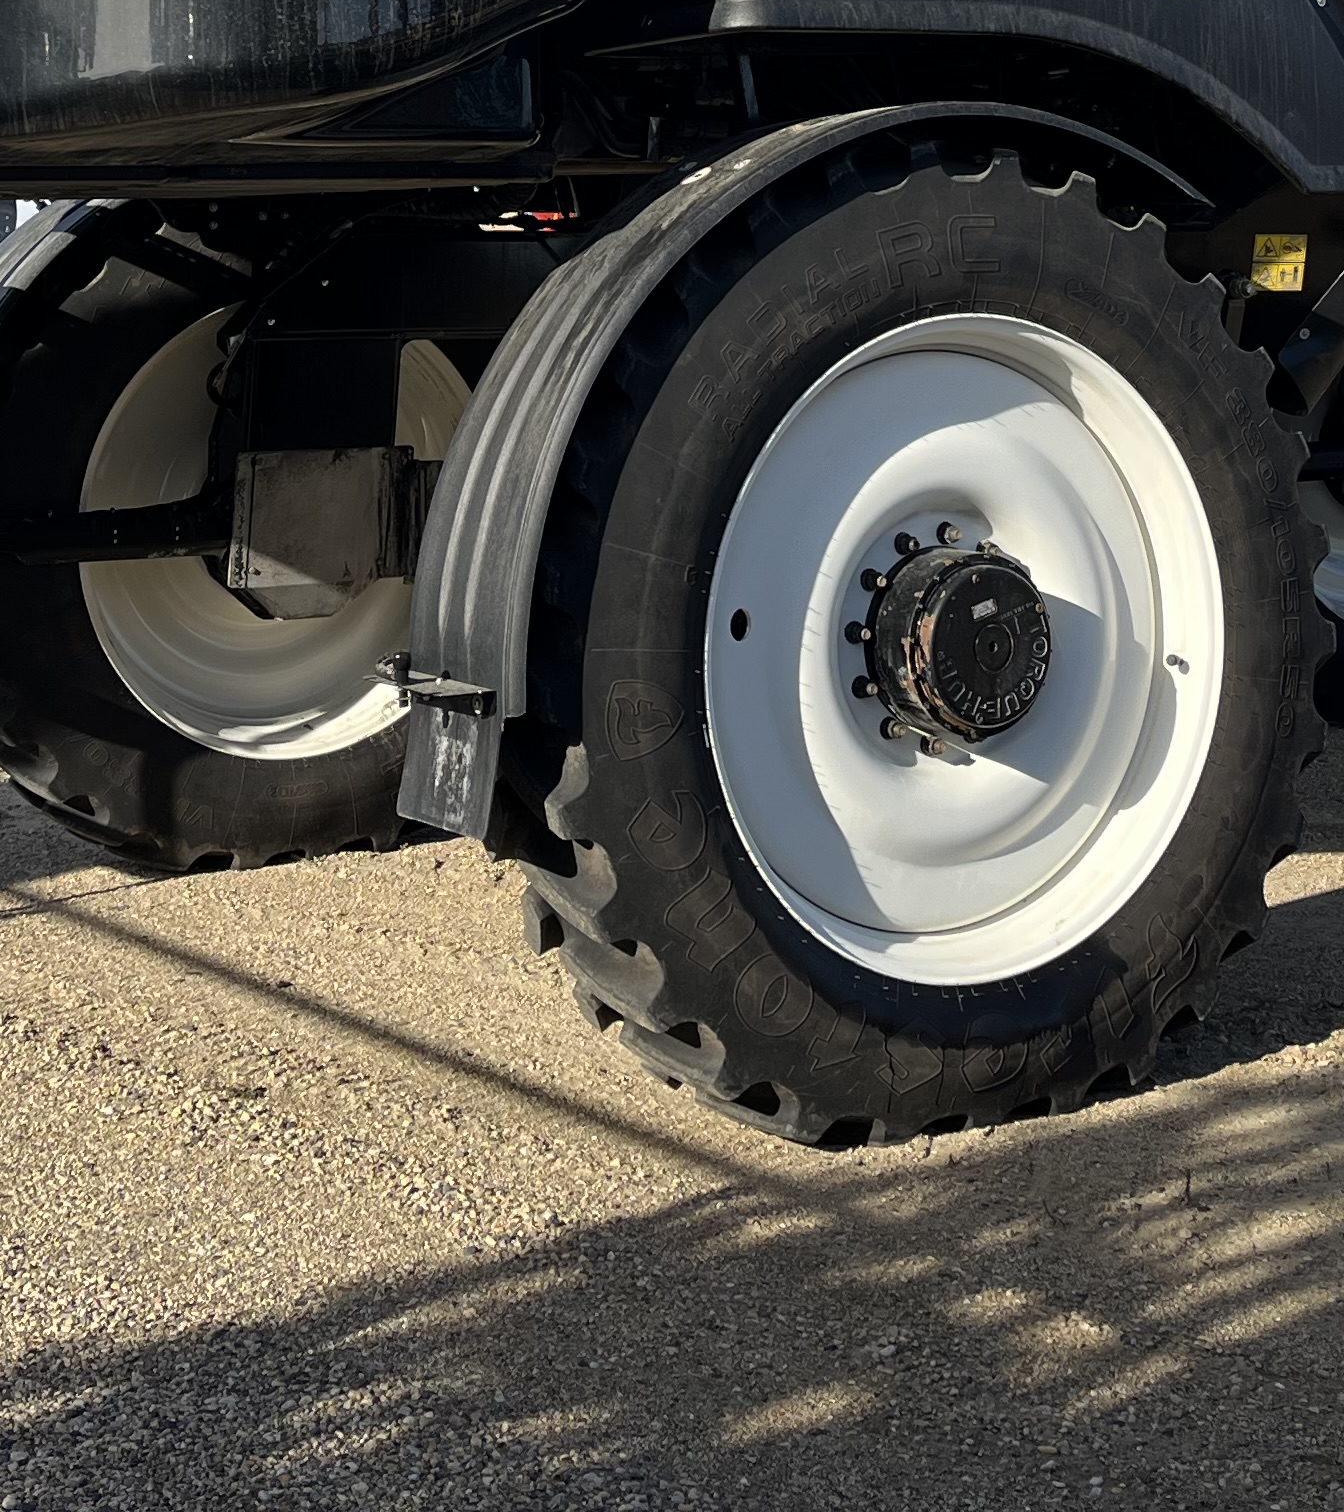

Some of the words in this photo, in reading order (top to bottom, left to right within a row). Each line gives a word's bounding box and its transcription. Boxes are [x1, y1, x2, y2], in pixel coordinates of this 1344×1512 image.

[687, 247, 870, 423] RADIAL
[757, 277, 882, 382] TRACTION
[875, 213, 1002, 289] RC
[1225, 386, 1300, 738] 380/105R50
[626, 790, 1199, 1096] Firestone
